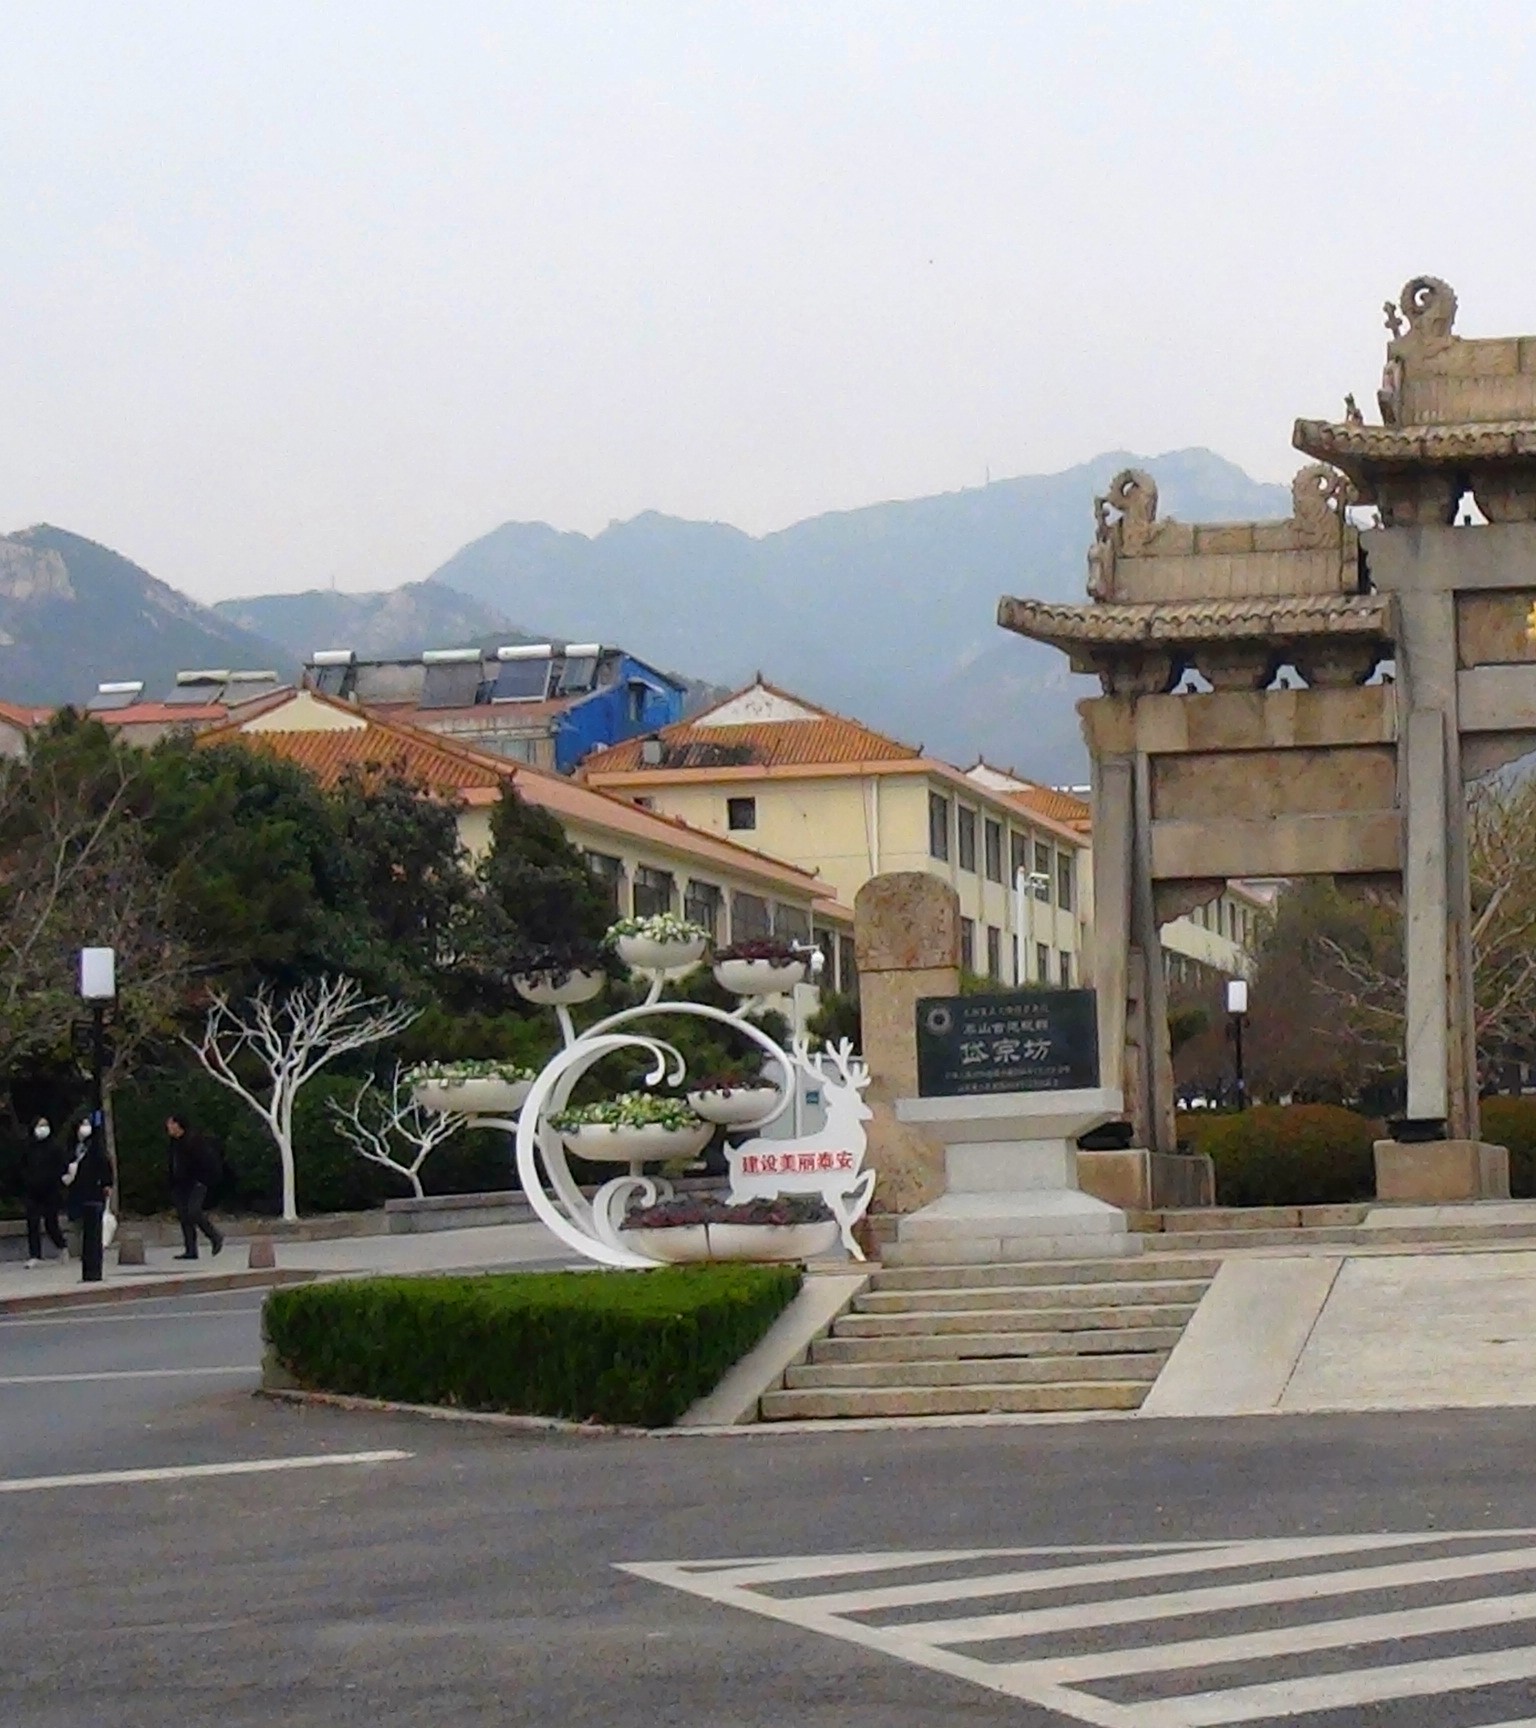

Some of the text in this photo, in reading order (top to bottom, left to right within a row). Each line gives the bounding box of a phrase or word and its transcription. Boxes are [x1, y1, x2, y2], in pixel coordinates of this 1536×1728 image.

[960, 1038, 1052, 1065] 岱宗坊
[742, 1150, 853, 1173] 建设美丽泰安
